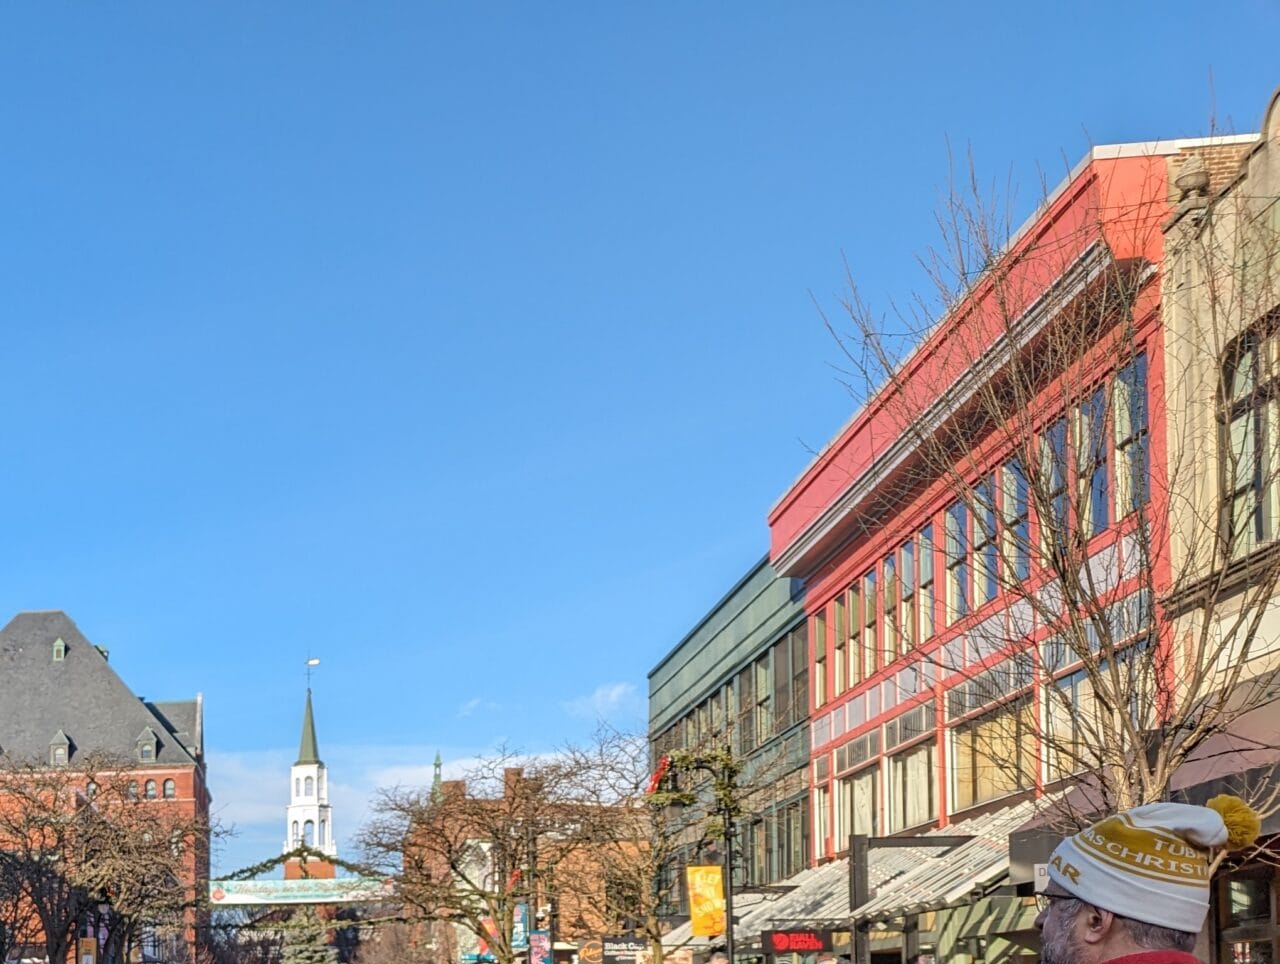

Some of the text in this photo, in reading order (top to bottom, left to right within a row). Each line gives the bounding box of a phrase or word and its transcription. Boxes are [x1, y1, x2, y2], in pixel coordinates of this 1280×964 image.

[1050, 855, 1081, 886] AR
[1082, 829, 1209, 877] AS CHRIST
